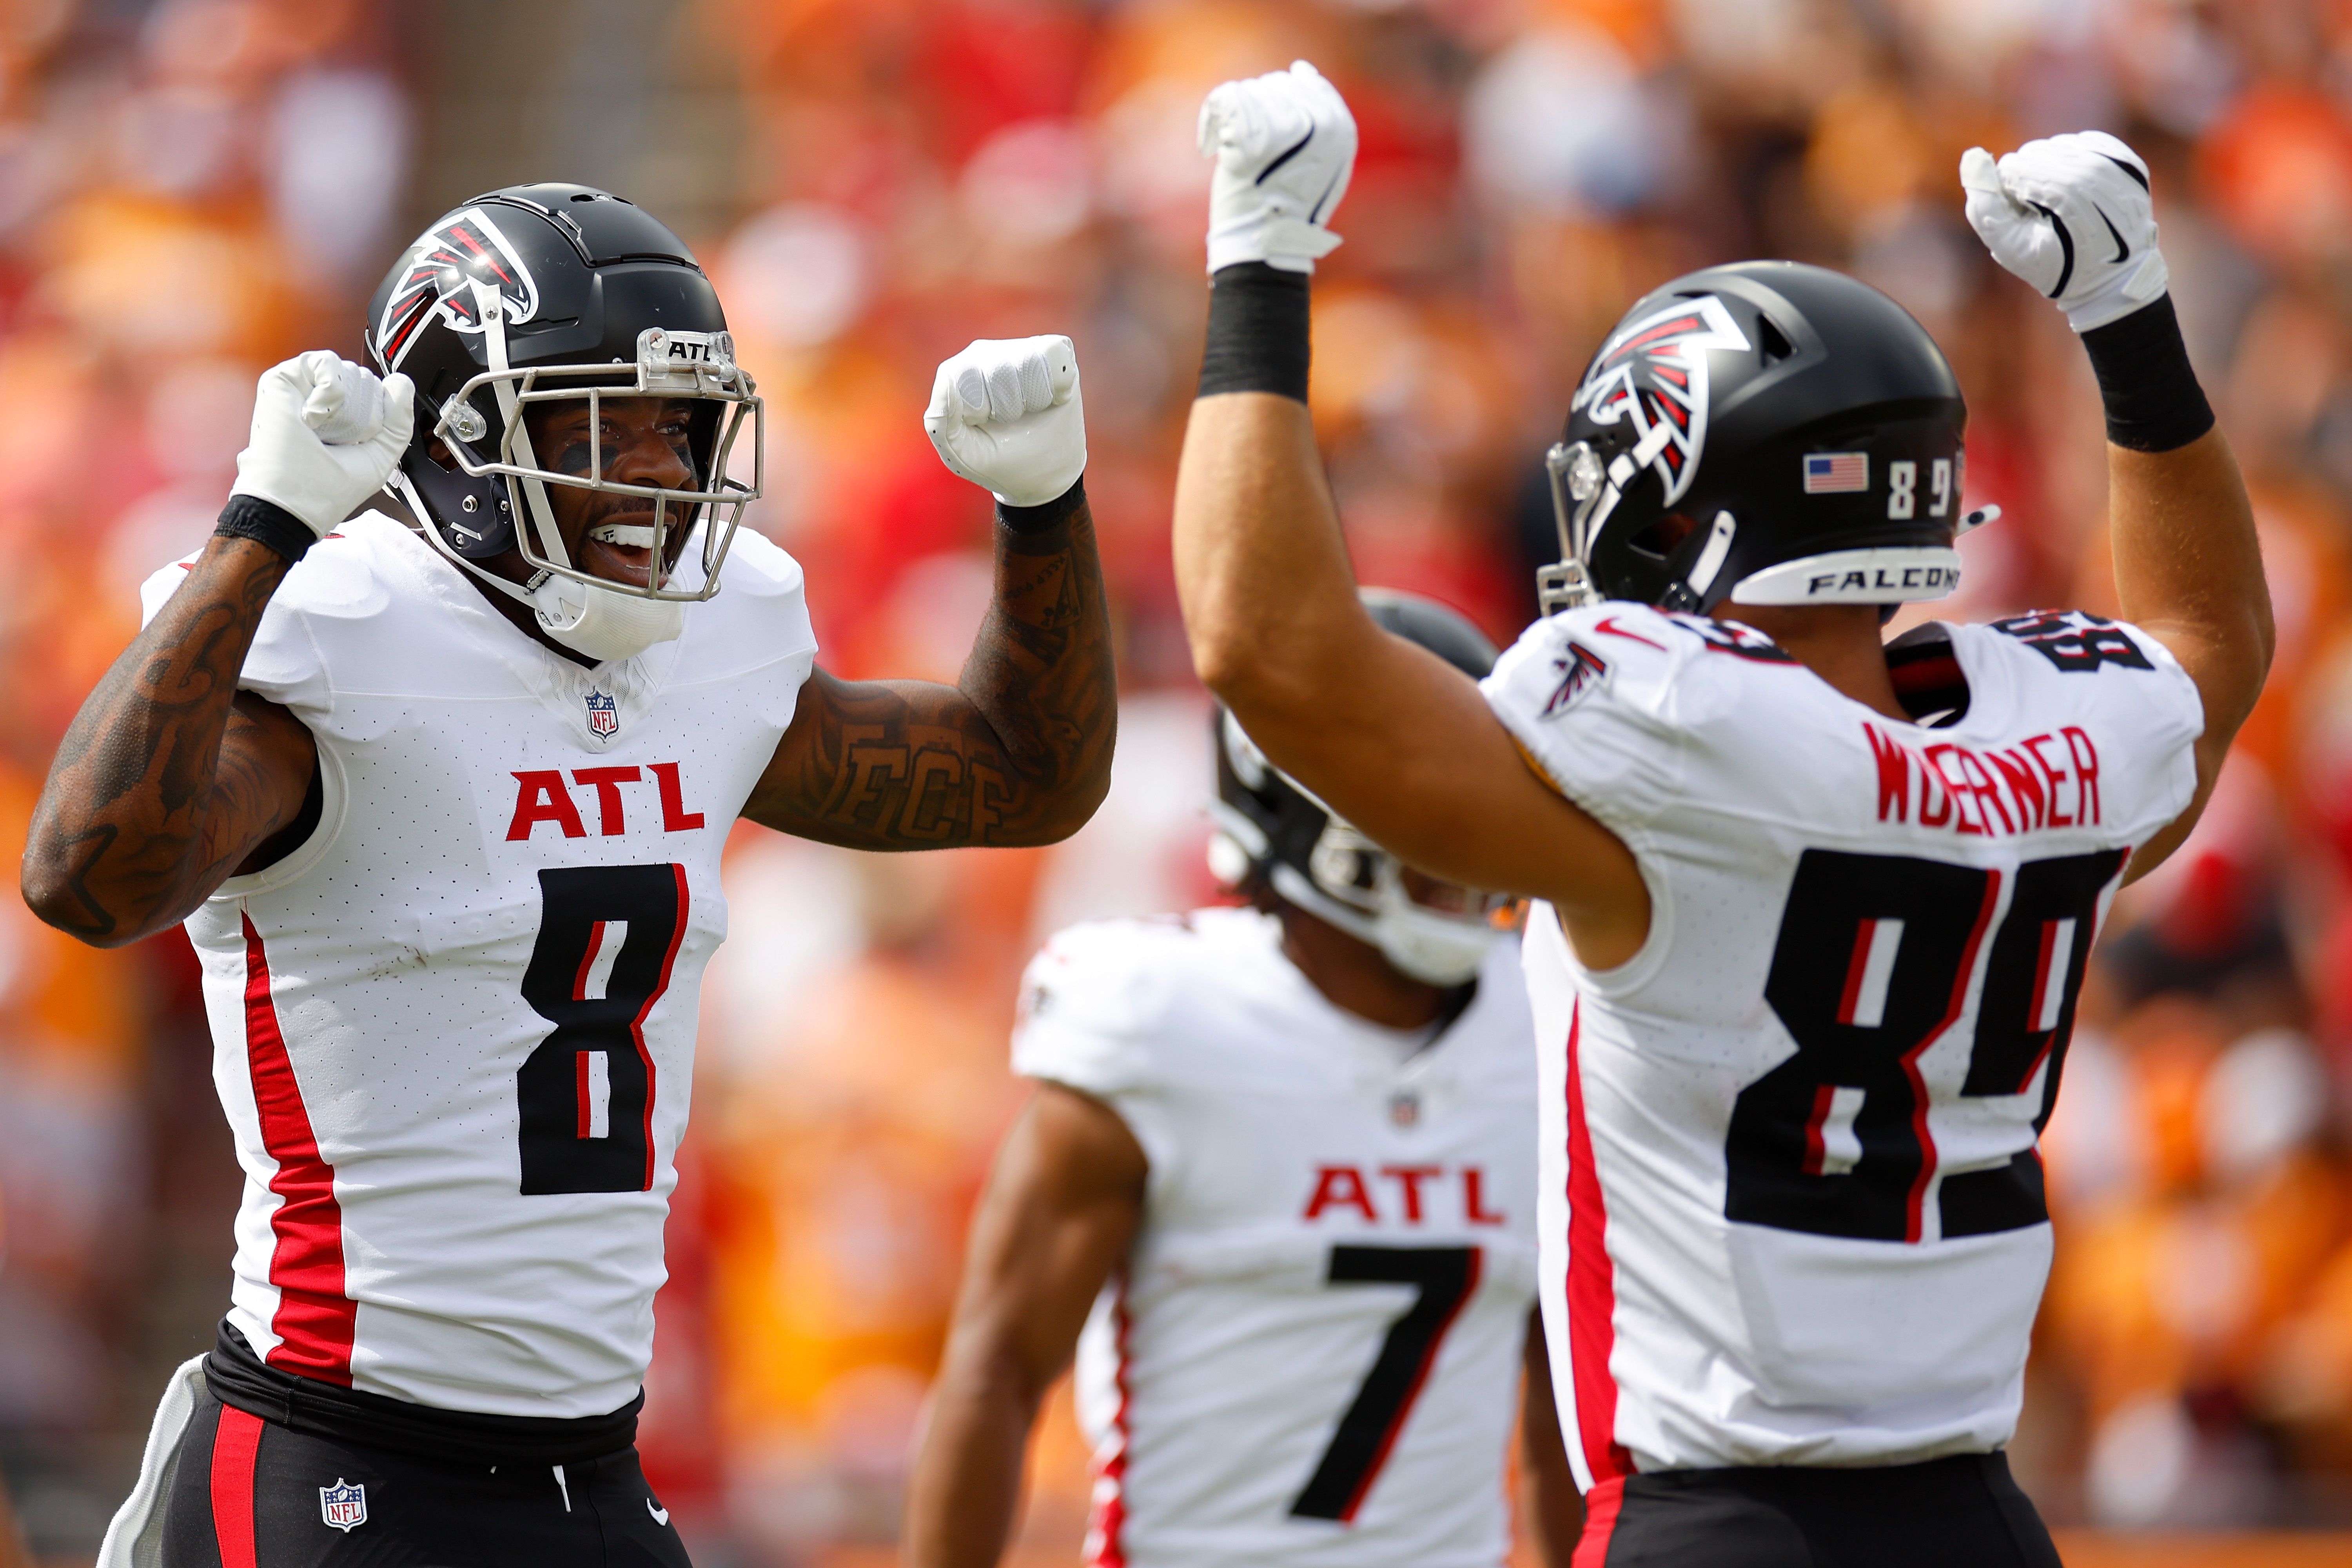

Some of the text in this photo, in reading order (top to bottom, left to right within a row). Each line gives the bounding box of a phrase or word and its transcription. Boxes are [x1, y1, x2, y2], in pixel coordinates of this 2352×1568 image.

[669, 341, 710, 361] ATL
[1887, 458, 1951, 520] 89
[1808, 568, 1960, 595] FALCON
[592, 711, 616, 732] NFL
[505, 762, 705, 841] ATL
[517, 863, 690, 1195] 8
[1725, 846, 2132, 1244] 89
[1301, 1161, 1508, 1227] ATL
[1288, 1241, 1485, 1526] 7
[330, 1503, 360, 1522] NFL
